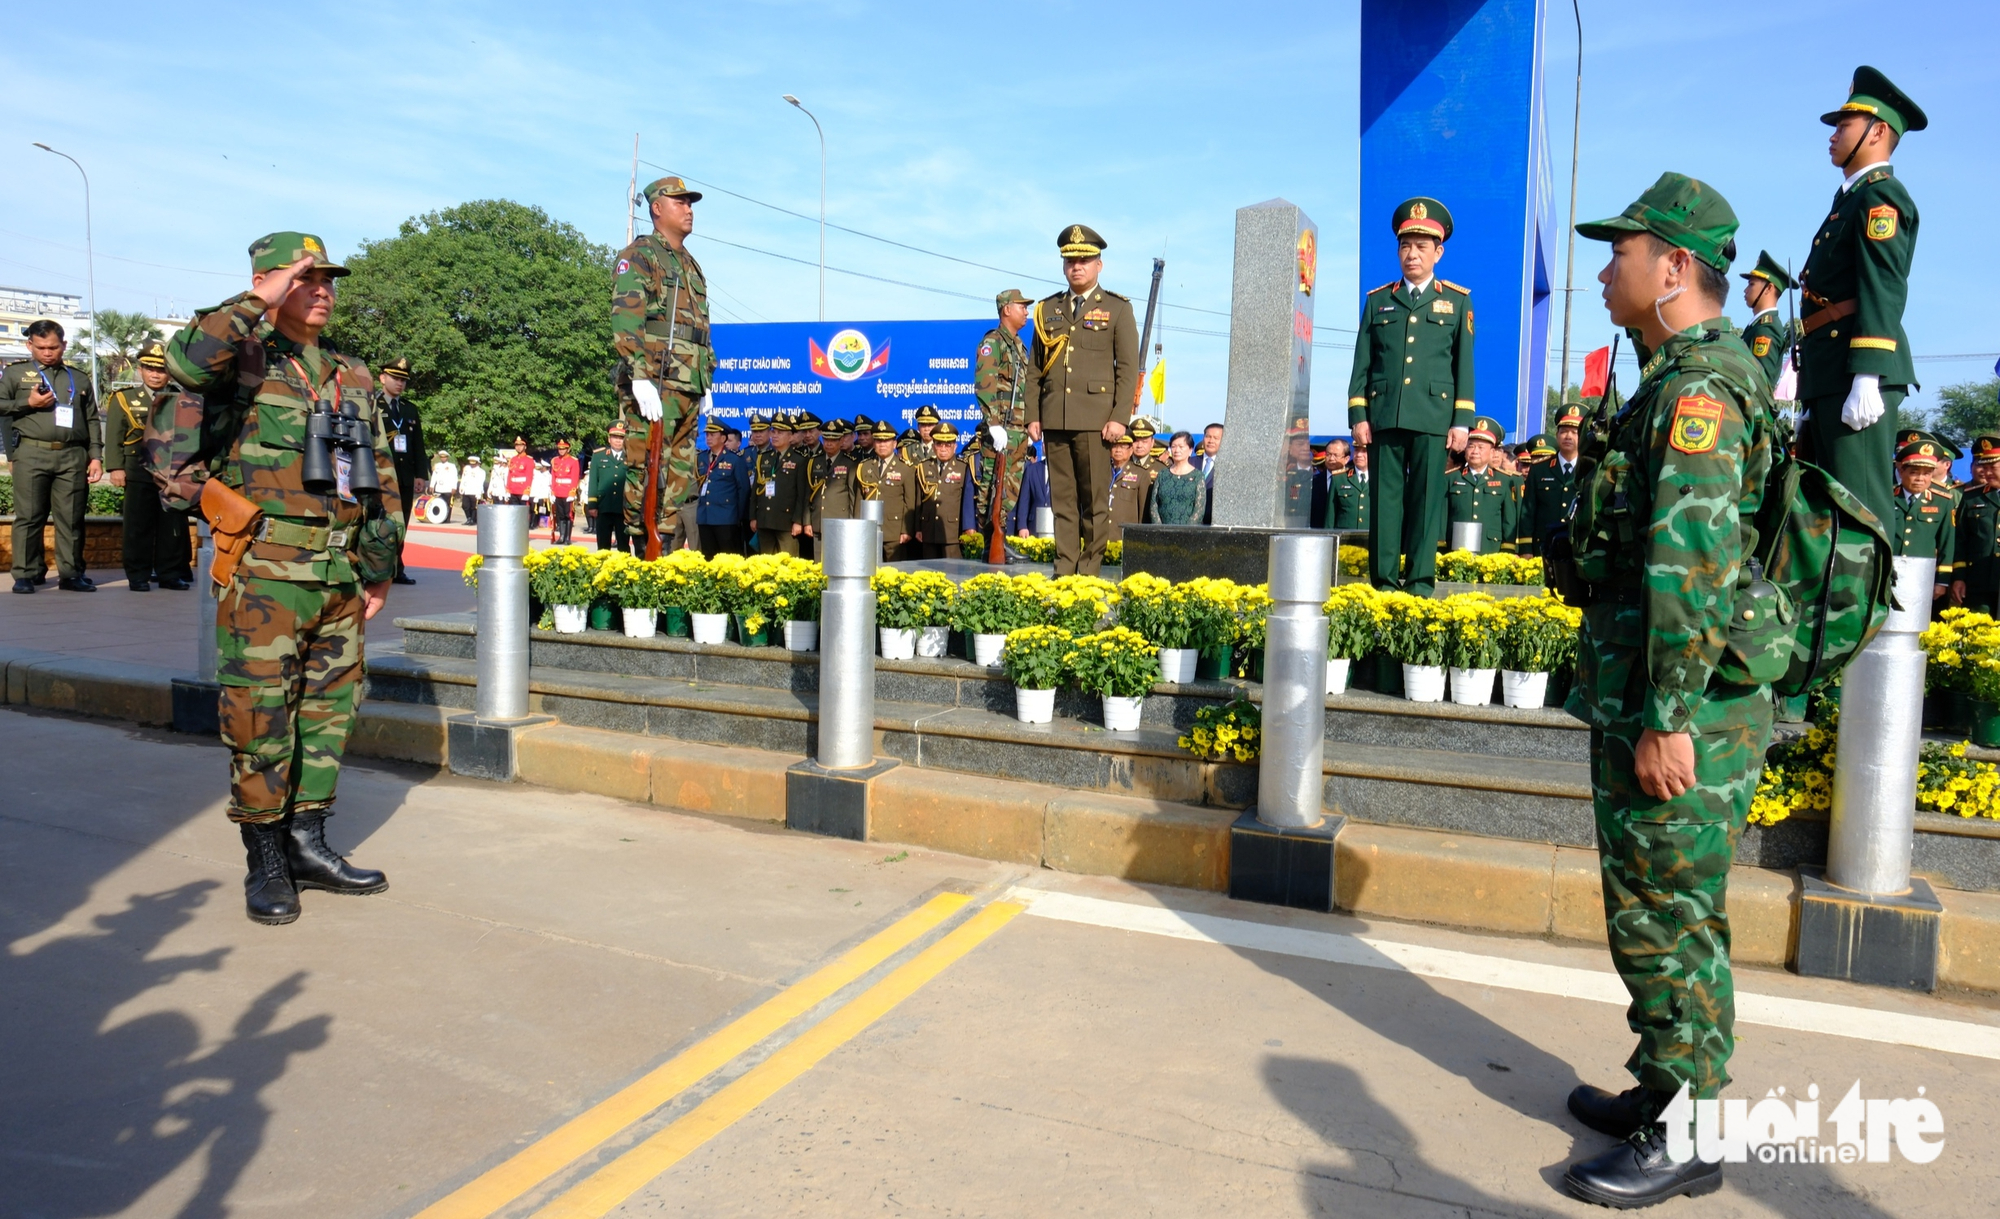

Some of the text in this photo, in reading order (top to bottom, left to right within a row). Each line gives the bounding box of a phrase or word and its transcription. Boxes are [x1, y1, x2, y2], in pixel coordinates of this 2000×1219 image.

[720, 356, 791, 371] NHIỆT LIỆT CHÀO MỪNG
[719, 381, 733, 394] HỮU
[734, 383, 749, 396] NGHỊ
[750, 381, 768, 394] QUỐC
[769, 381, 791, 394] PHÒNG
[792, 381, 807, 394] BIÊN
[808, 381, 822, 394] GIỚI
[759, 408, 773, 419] NAM
